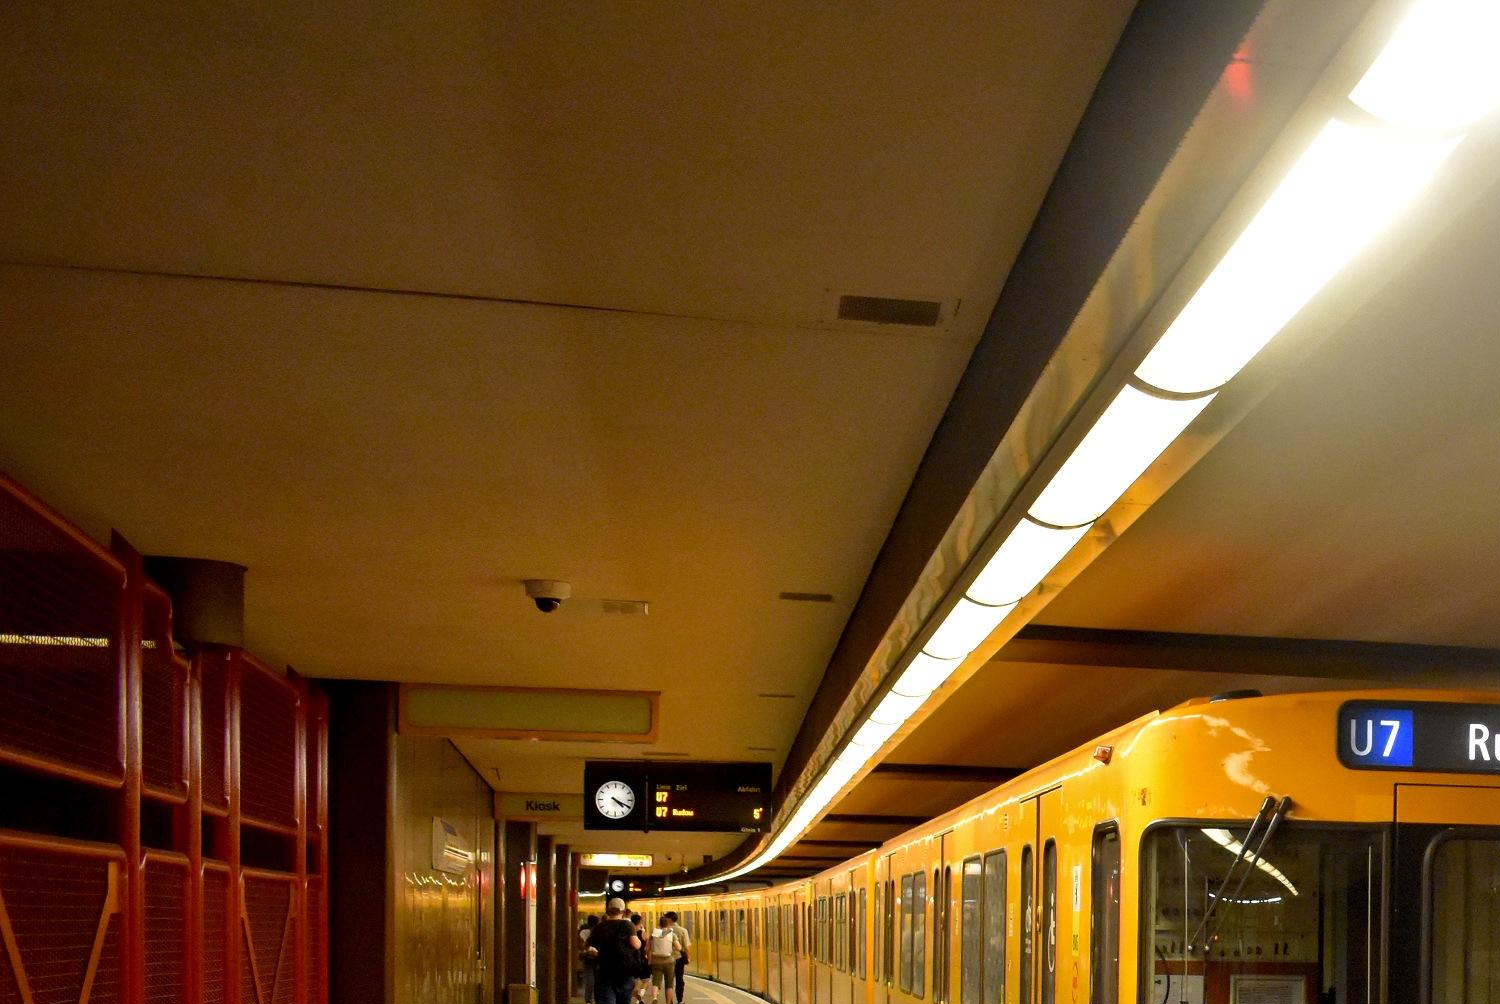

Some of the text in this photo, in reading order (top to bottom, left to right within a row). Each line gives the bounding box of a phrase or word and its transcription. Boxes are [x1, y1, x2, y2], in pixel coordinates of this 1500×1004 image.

[1350, 718, 1401, 758] U7
[655, 791, 669, 802] U7
[525, 800, 561, 812] Kiosk
[655, 806, 669, 818] U7
[672, 808, 694, 817] Rudow
